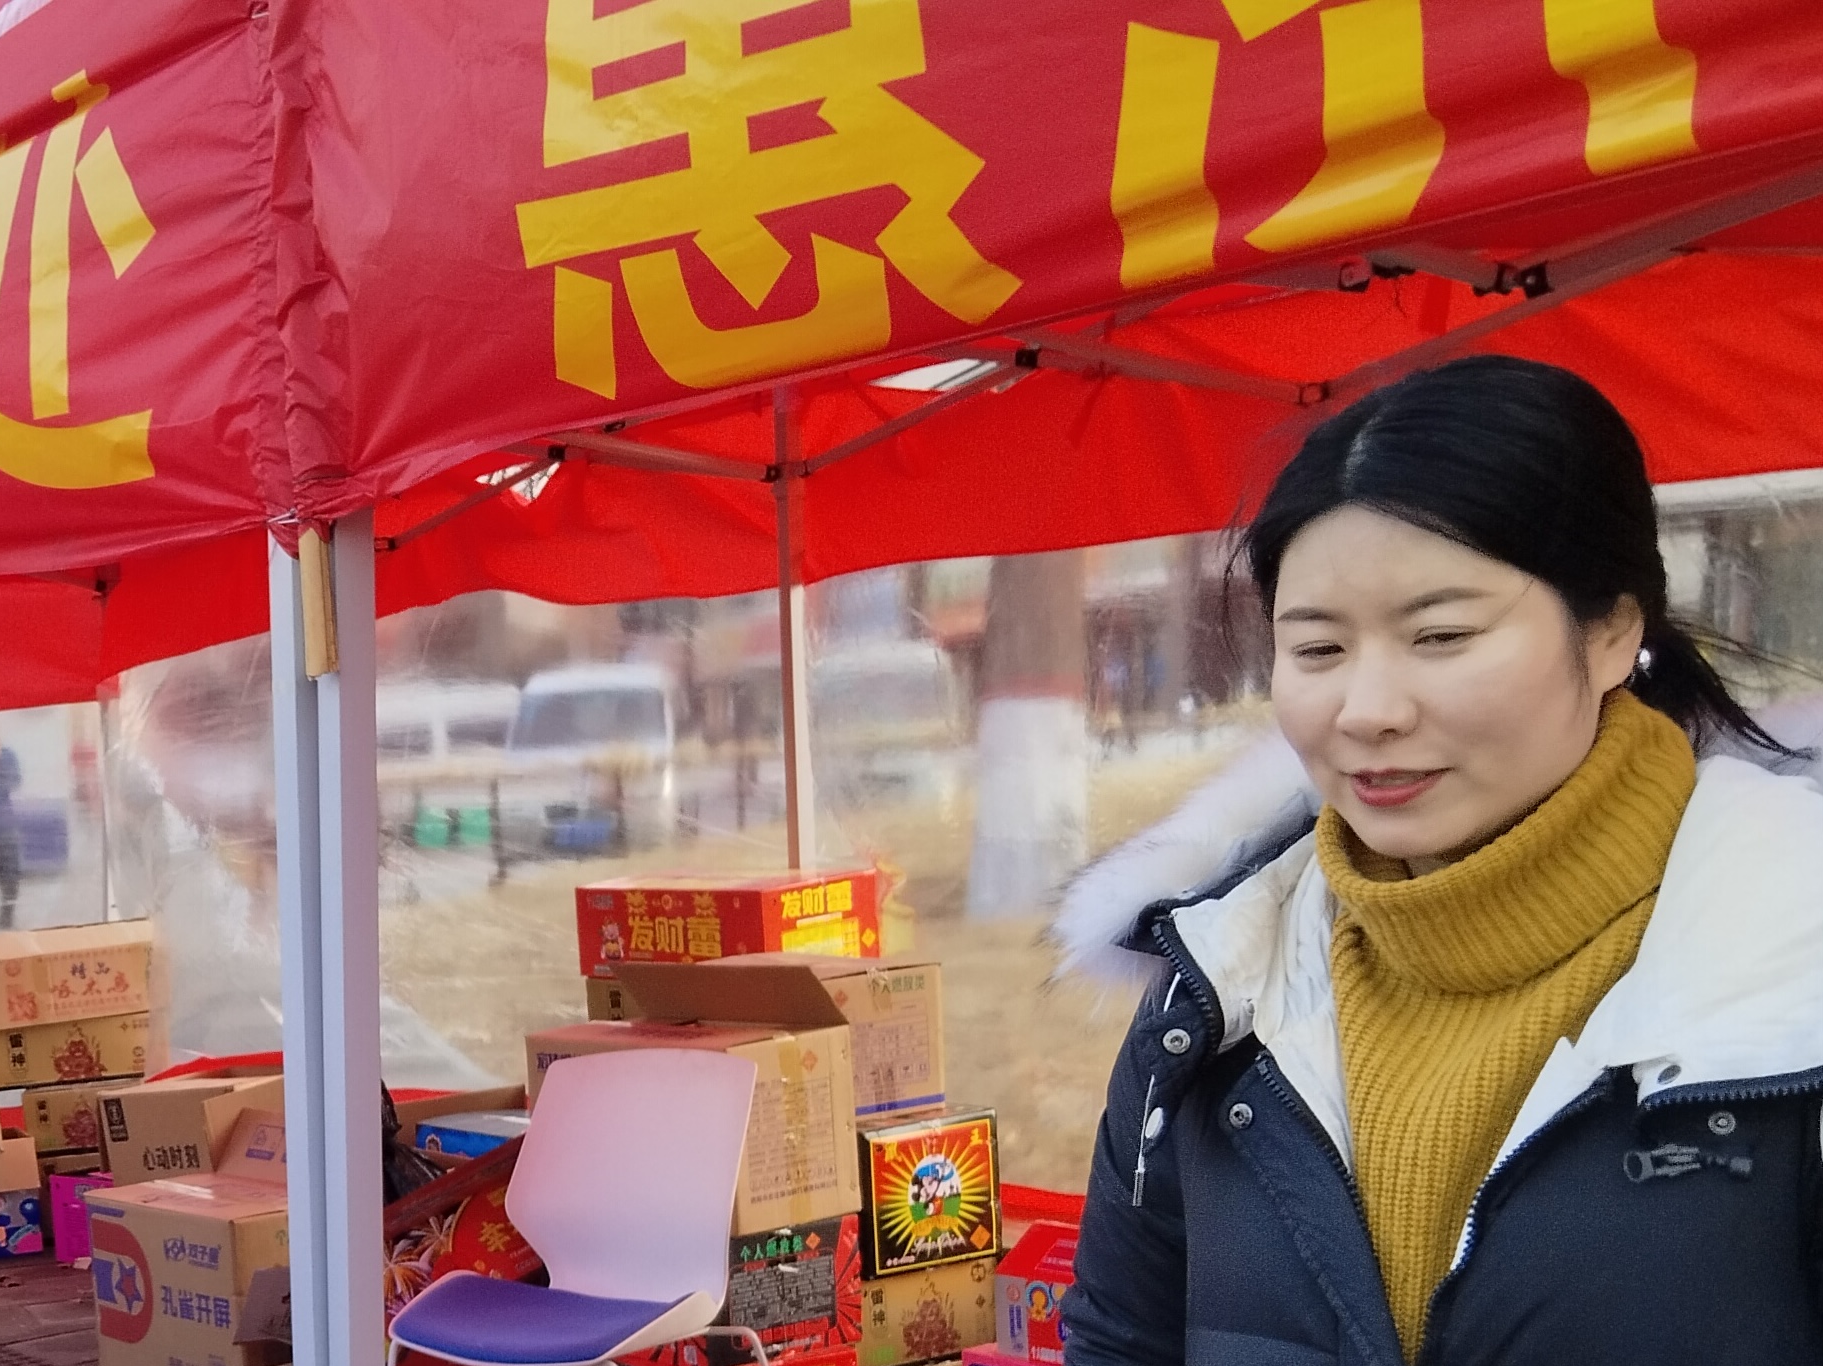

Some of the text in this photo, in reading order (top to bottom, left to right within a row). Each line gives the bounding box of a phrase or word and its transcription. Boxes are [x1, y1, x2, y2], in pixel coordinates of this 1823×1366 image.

[142, 1145, 201, 1171] 心动时刻
[161, 1285, 232, 1329] 孔雀开屏
